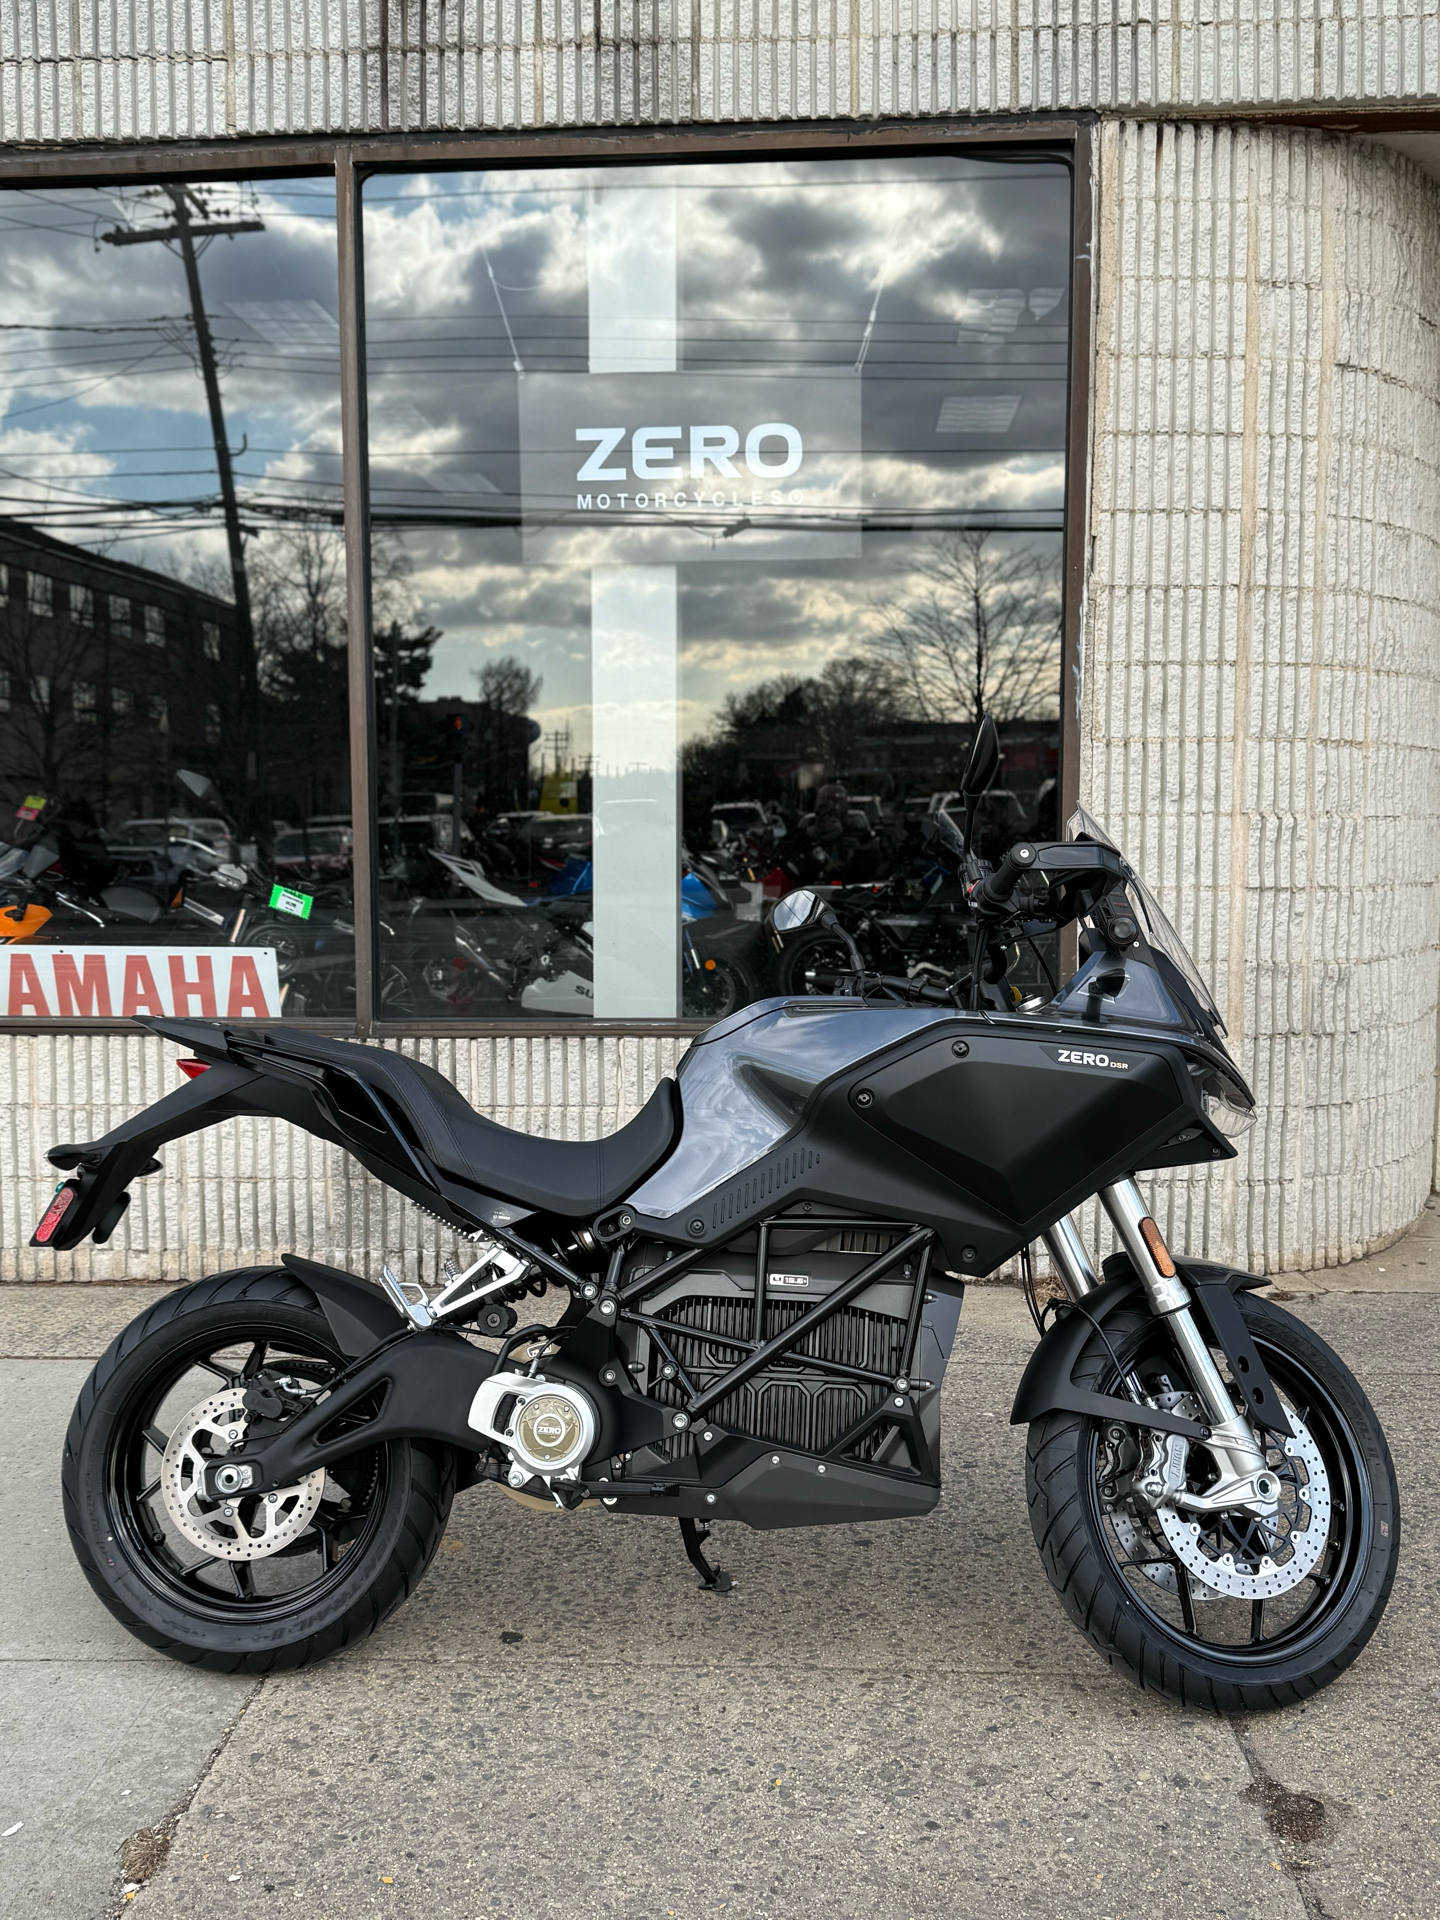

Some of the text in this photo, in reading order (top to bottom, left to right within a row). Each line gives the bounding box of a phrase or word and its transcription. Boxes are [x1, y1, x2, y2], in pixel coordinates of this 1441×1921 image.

[576, 423, 803, 481] ZERO
[1057, 1049, 1110, 1067] ZERO
[537, 1426, 562, 1434] ZERO
